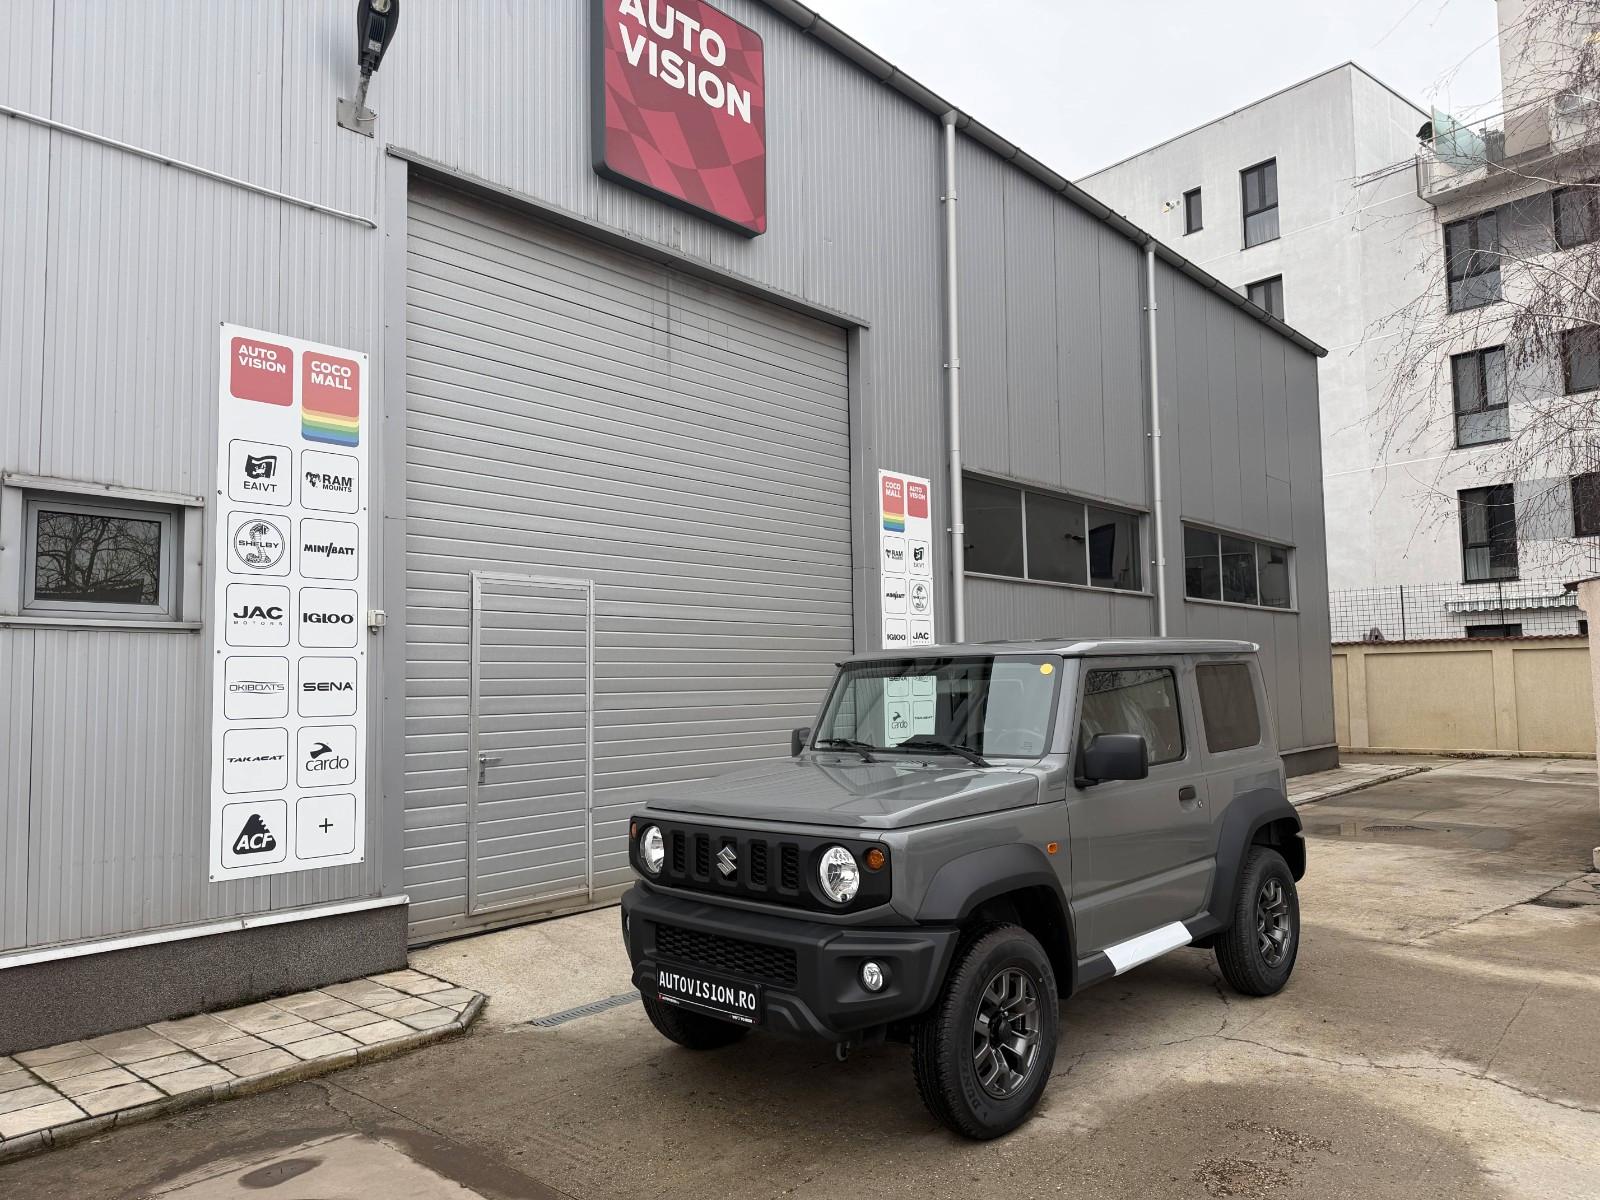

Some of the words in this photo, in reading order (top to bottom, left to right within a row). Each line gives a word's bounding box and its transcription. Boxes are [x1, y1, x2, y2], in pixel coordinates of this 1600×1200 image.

[618, 22, 751, 124] VISION
[239, 344, 277, 361] AUTO
[238, 356, 286, 374] VISION
[311, 360, 351, 377] COCO
[311, 372, 352, 390] MALL
[243, 480, 277, 493] EAIVT
[322, 474, 353, 487] RAM
[322, 484, 353, 493] MOUNTS
[238, 540, 279, 549] SHELBY
[233, 605, 283, 620] JAC
[303, 612, 354, 624] IGLOO
[887, 633, 906, 641] IGLOO
[912, 632, 929, 640] JAC
[303, 682, 353, 692] SENA
[227, 755, 285, 763] TAKACAT
[305, 756, 350, 772] cardo
[236, 832, 273, 851] ACF
[659, 970, 756, 1011] AUTOVISION.RO
